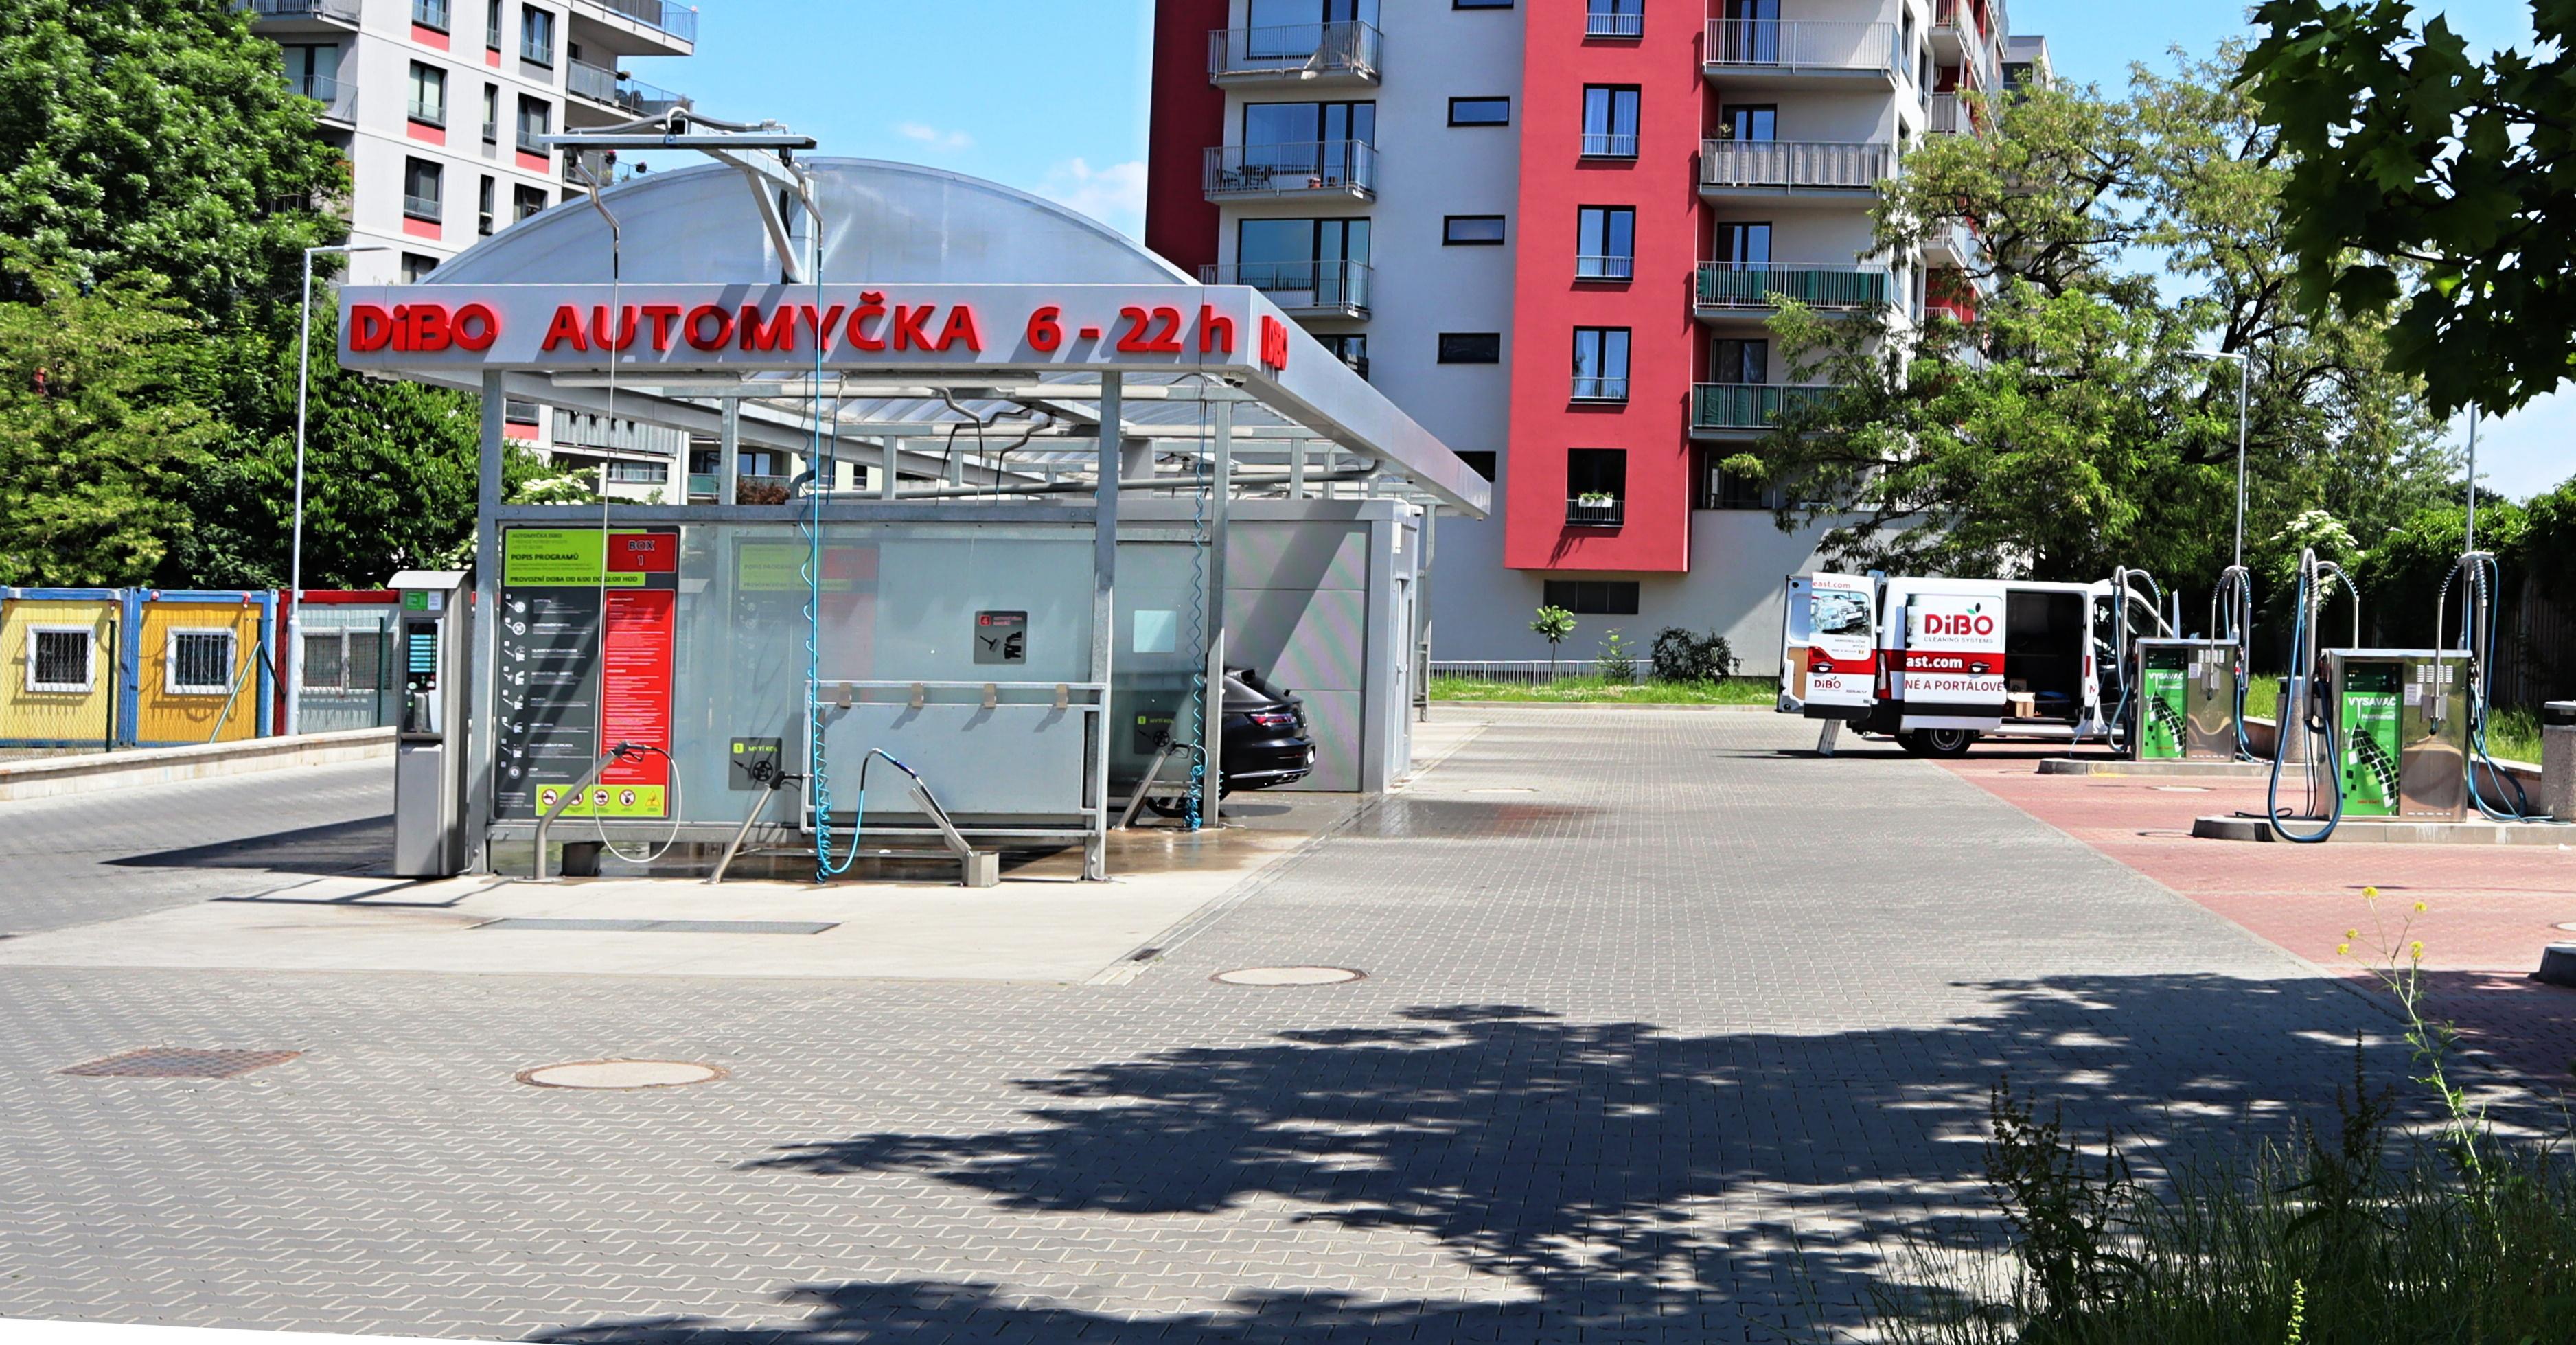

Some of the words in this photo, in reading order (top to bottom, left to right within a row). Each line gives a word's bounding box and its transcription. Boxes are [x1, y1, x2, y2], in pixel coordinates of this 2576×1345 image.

[350, 303, 499, 352] DiBO
[542, 291, 982, 352] AUTOMYČKA
[1027, 306, 1061, 352] 6
[1116, 307, 1183, 352] 22
[1199, 305, 1232, 352] h
[628, 540, 655, 551] BOX
[535, 552, 579, 560] PROGRAMŮ
[637, 555, 643, 566] 1
[1925, 614, 1994, 636] DiBO
[1906, 656, 1963, 668] ast.com
[1923, 680, 1931, 690] A
[1935, 679, 2003, 691] PORTÁLOVÉ
